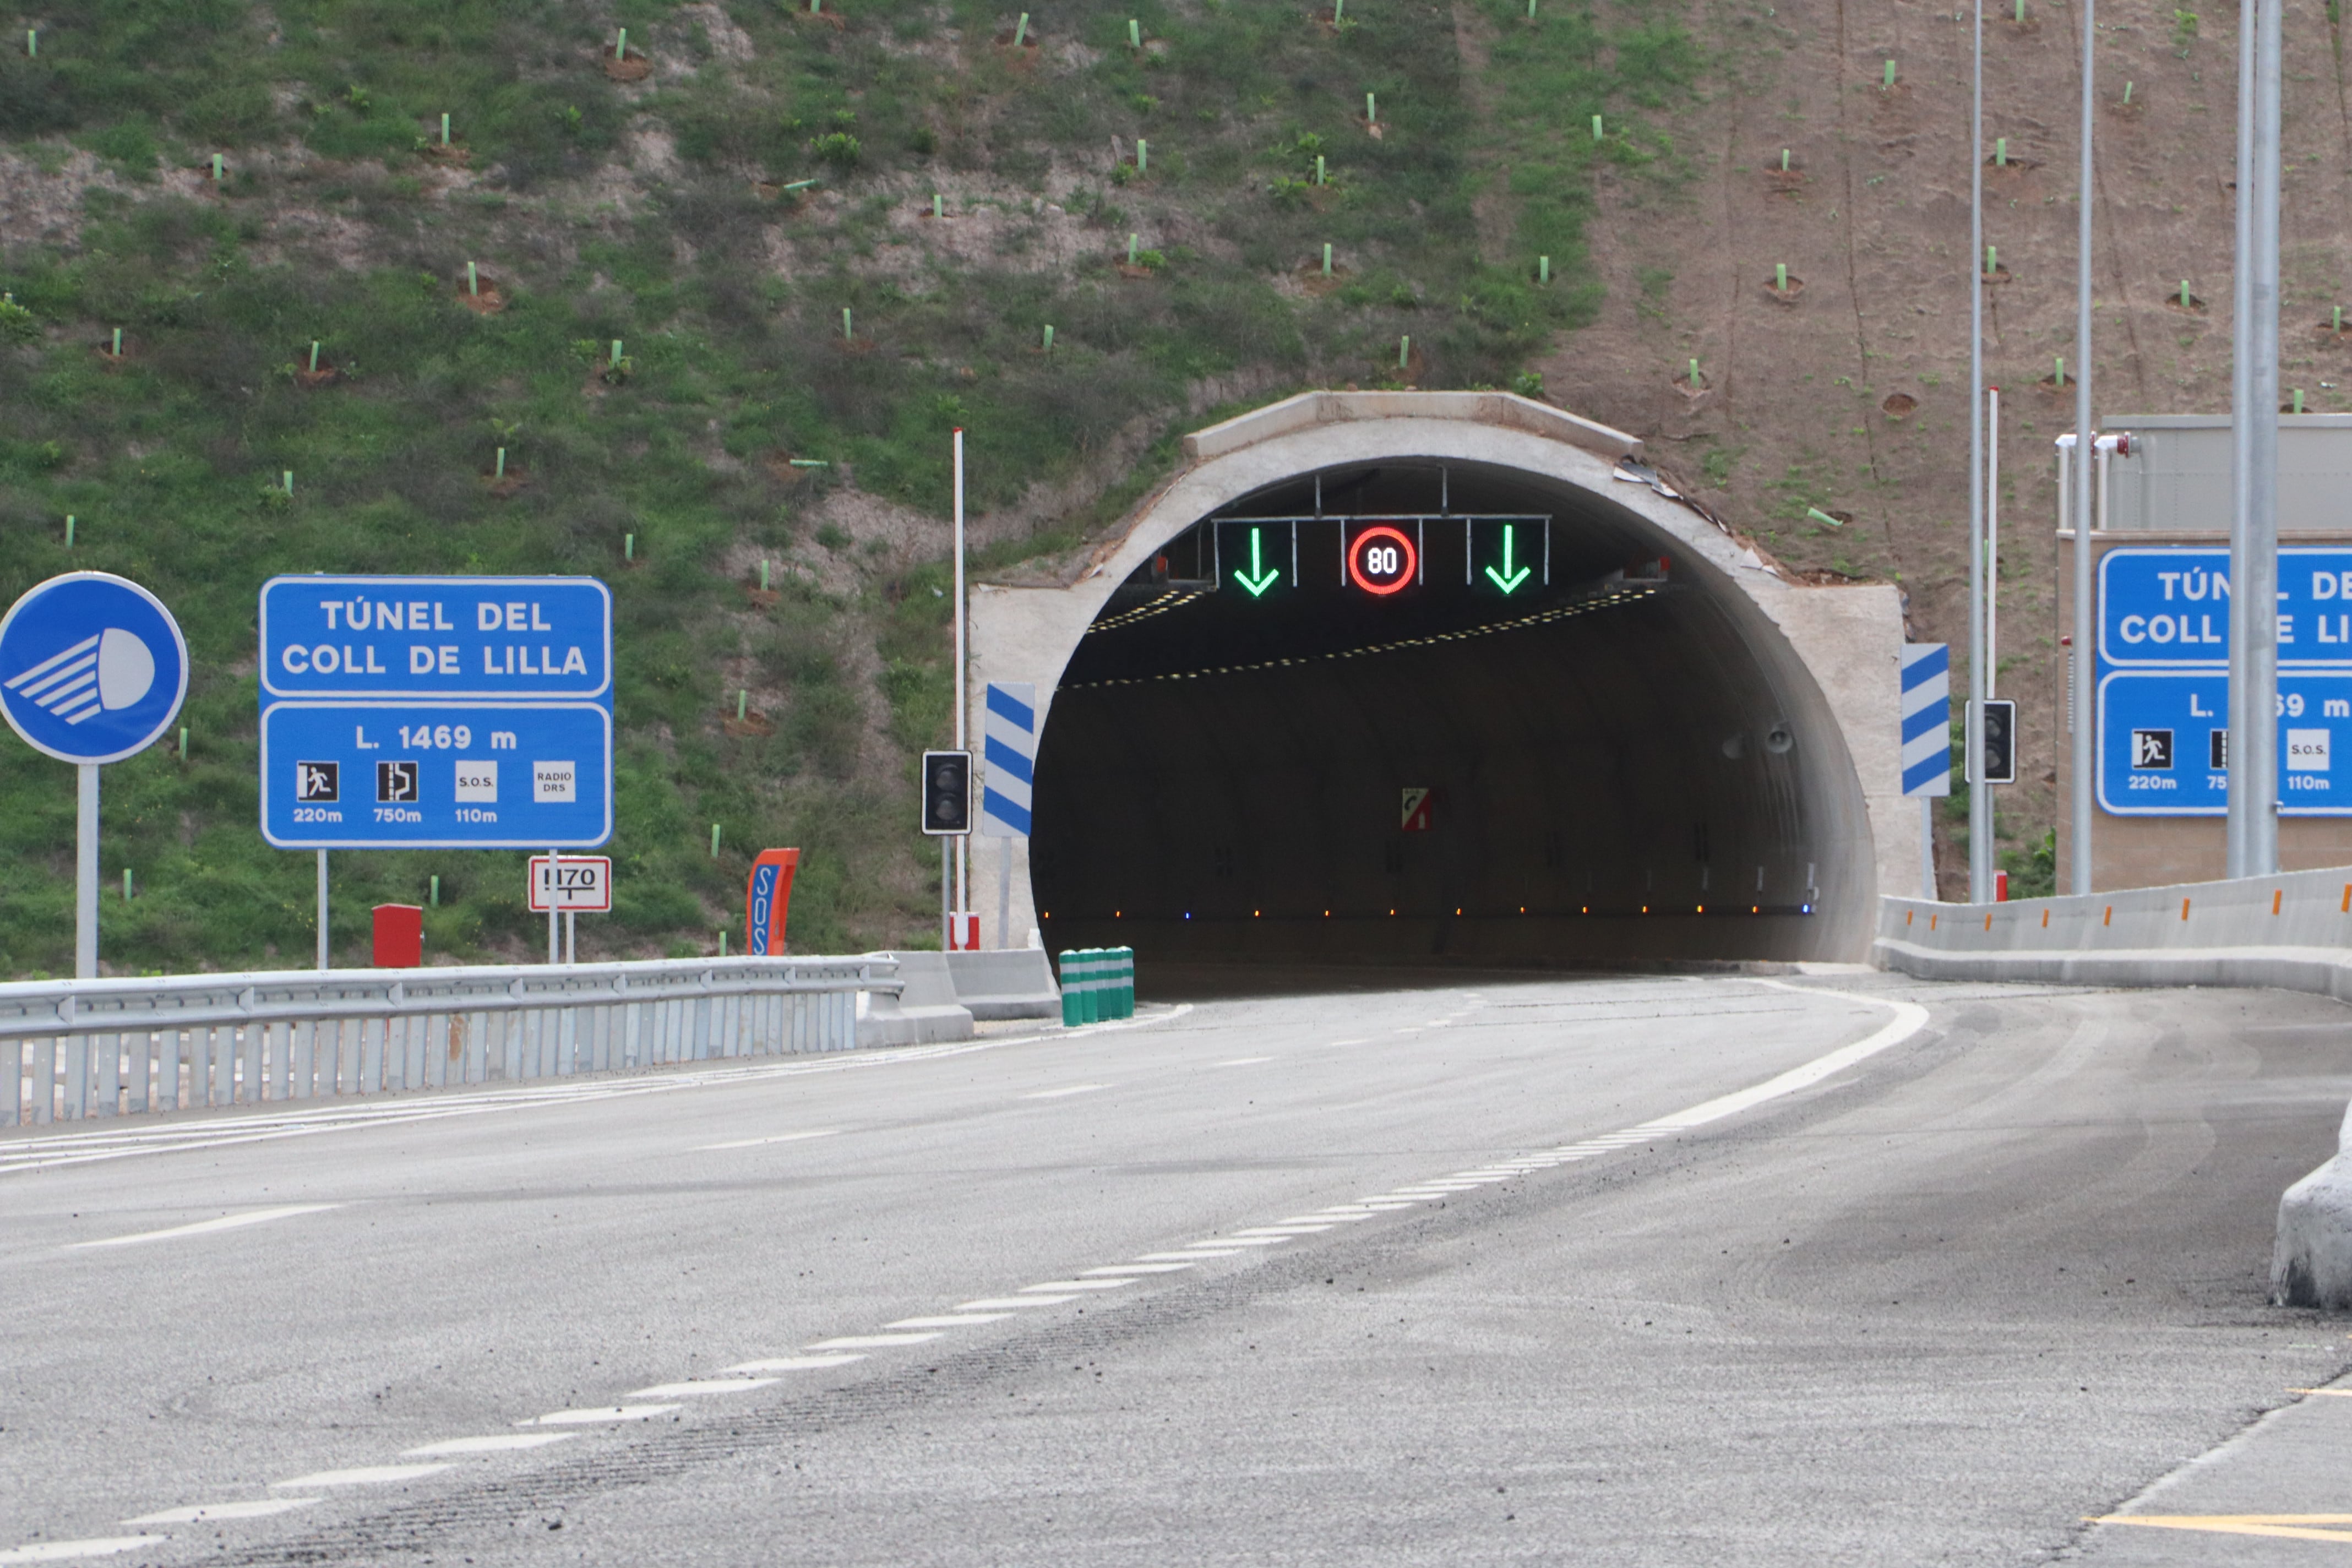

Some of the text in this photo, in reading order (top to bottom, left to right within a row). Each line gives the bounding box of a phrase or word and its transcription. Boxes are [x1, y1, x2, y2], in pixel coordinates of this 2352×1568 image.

[1368, 547, 1397, 574] 80
[2158, 566, 2289, 601] TÚN
[320, 596, 551, 631] TÚNEL DEL
[2120, 614, 2222, 644] COLL
[2277, 614, 2294, 644] E
[282, 644, 587, 674] COLL DE LILLA
[2191, 694, 2214, 717] L.
[2323, 699, 2350, 717] m
[356, 725, 516, 749] L. 1469 m
[2291, 744, 2326, 755] S.O.S.
[459, 777, 494, 787] S.O.S.
[537, 772, 571, 781] RADIO
[2128, 775, 2177, 790] 220m
[2207, 775, 2228, 790] 75
[2288, 775, 2330, 790] 110m
[293, 808, 342, 822] 220m
[373, 808, 422, 823] 750m
[455, 808, 497, 823] 110m
[754, 867, 771, 955] SOS
